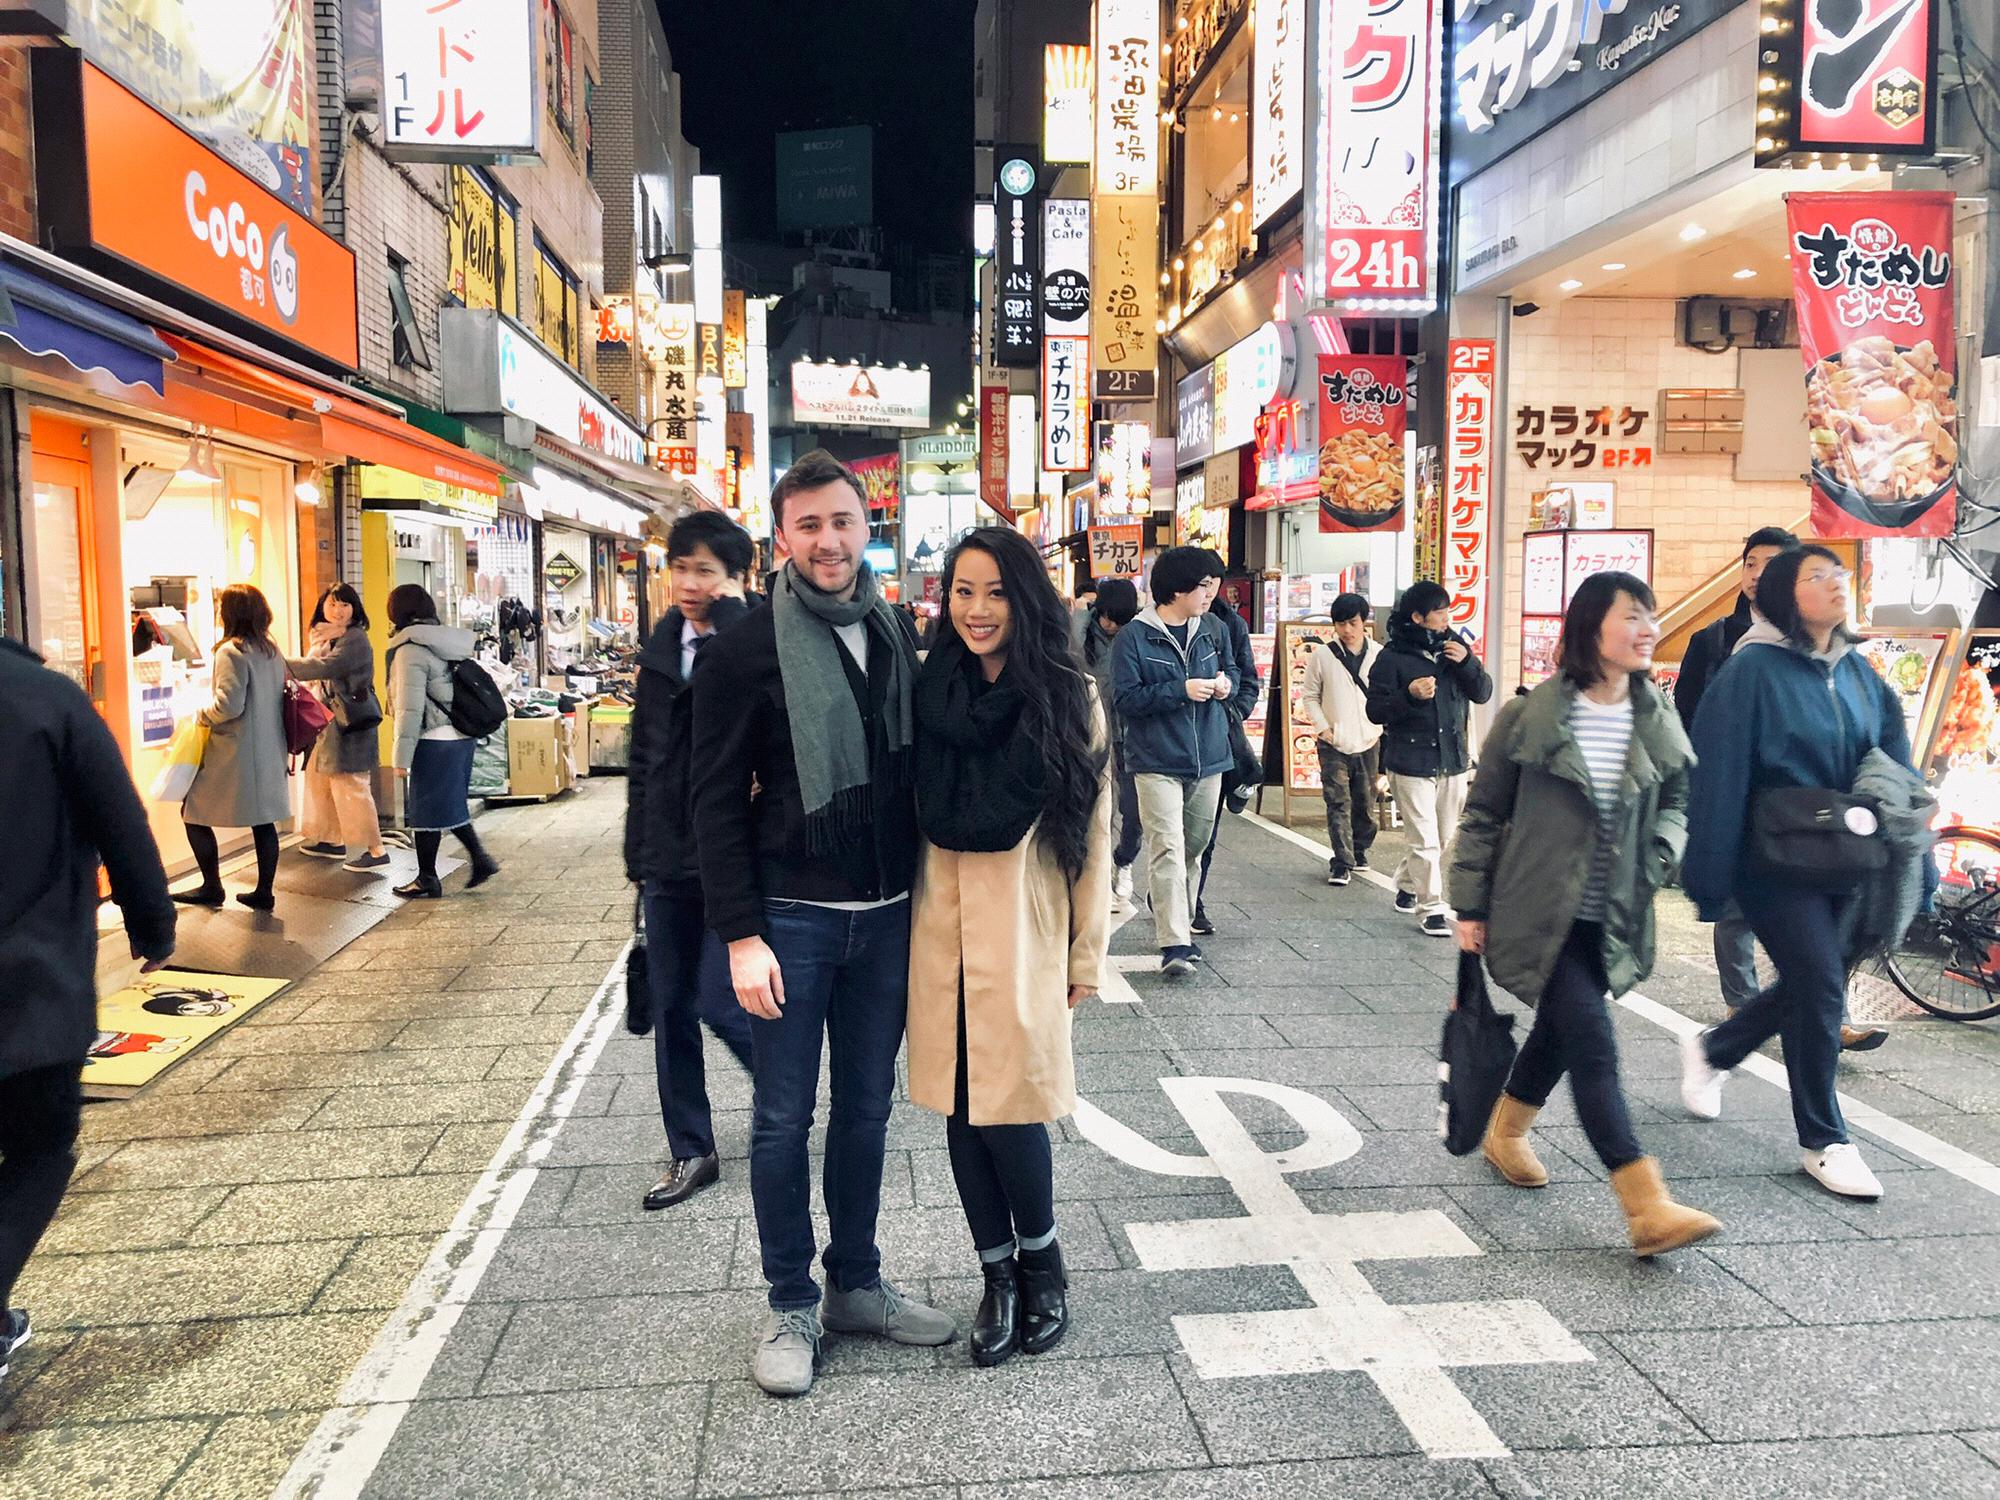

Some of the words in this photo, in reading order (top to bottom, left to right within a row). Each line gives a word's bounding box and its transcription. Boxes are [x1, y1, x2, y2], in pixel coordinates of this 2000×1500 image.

[1343, 0, 1415, 112] ク
[1596, 23, 1648, 71] Karaoke
[426, 0, 485, 138] ドル
[395, 72, 414, 136] 1F
[1115, 172, 1140, 190] 3F
[1048, 205, 1087, 216] Pasta
[1063, 217, 1072, 228] &
[1052, 228, 1083, 239] Cafe
[1330, 238, 1420, 289] 24h
[1795, 224, 1950, 290] すためし
[1044, 285, 1089, 301] 壁の穴
[1004, 272, 1026, 346] 小肥羊
[701, 325, 720, 374] BAR
[1453, 346, 1490, 369] 2F
[665, 345, 687, 441] 磯丸水産
[1108, 371, 1141, 391] 2F
[1322, 369, 1404, 406] すためし
[836, 414, 857, 422] 11.21
[859, 415, 892, 424] Release
[1051, 355, 1072, 465] チカラめし
[1516, 405, 1650, 436] カラオケ
[660, 449, 694, 461] 24h
[1516, 440, 1597, 468] マック
[1603, 449, 1629, 468] 2F
[1093, 531, 1110, 541] 東京
[1094, 541, 1138, 559] チカラ
[1573, 553, 1642, 572] カラオケ
[1115, 559, 1138, 574] めし
